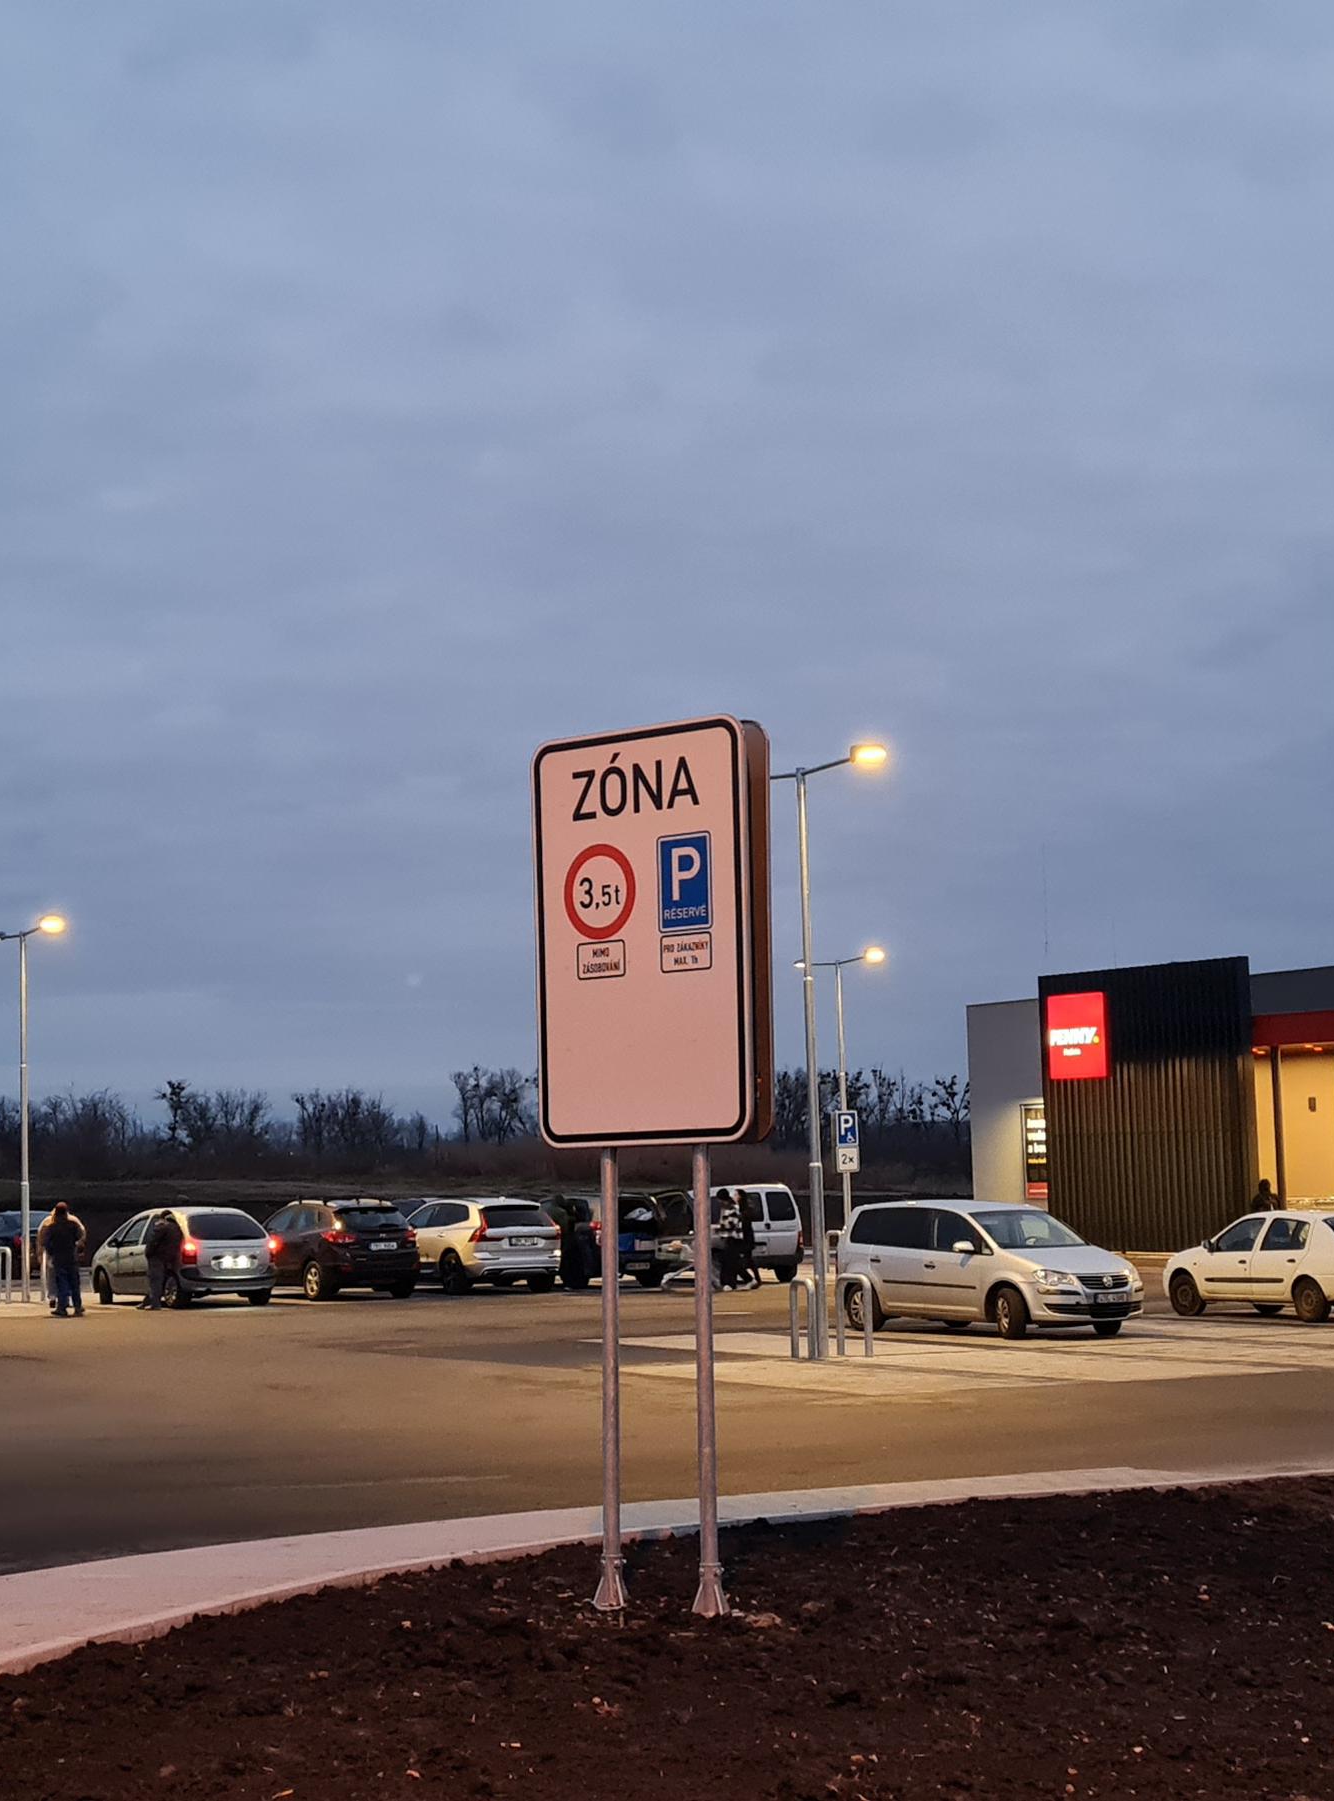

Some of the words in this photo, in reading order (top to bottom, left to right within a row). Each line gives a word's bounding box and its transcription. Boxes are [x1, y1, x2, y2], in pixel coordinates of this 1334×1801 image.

[572, 752, 700, 822] ZÓNA
[671, 846, 701, 901] P
[592, 947, 610, 959] MIMO
[840, 1115, 853, 1135] P
